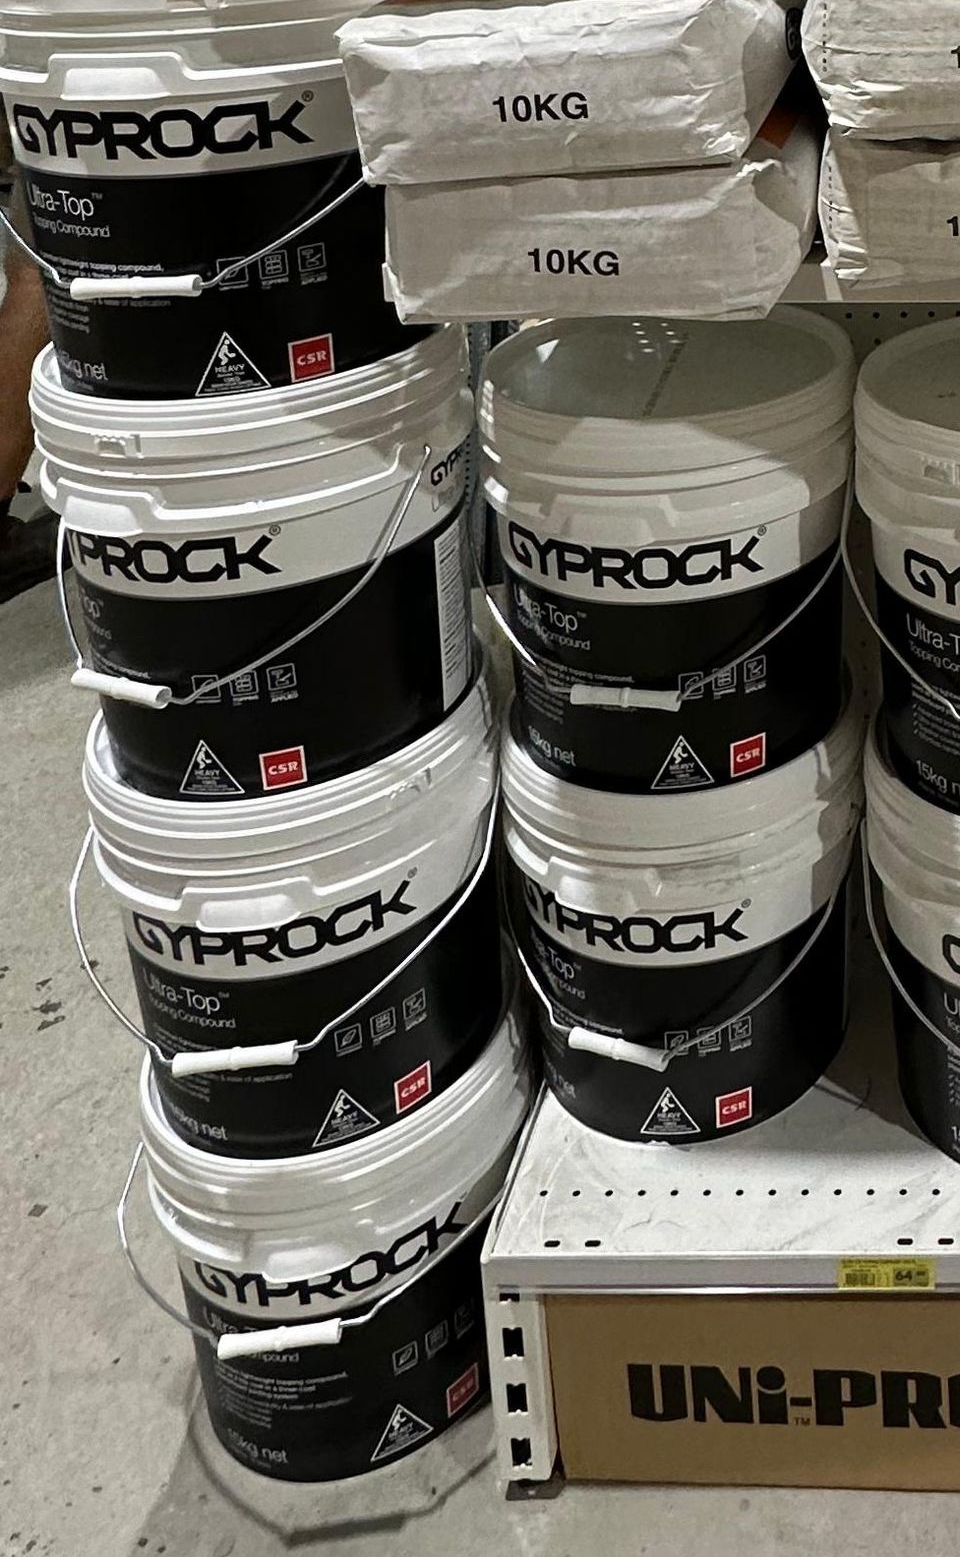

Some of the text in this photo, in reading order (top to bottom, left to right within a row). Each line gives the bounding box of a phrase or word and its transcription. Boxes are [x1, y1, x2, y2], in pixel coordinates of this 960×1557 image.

[493, 91, 589, 123] 10KG
[13, 99, 314, 161] GYPROCK
[527, 247, 621, 278] 10KG
[299, 350, 328, 370] CSR
[214, 363, 245, 379] HEAVY
[507, 519, 766, 590] GYPROCK
[553, 747, 577, 767] net
[735, 749, 761, 765] CSR
[193, 768, 222, 779] HEAVY
[267, 759, 300, 777] CSR
[915, 759, 948, 795] 15kg
[133, 879, 417, 966] GYPROCK
[400, 1079, 427, 1099] CSR
[721, 1102, 748, 1117] CSR
[203, 1116, 229, 1142] net
[262, 1444, 289, 1464] net
